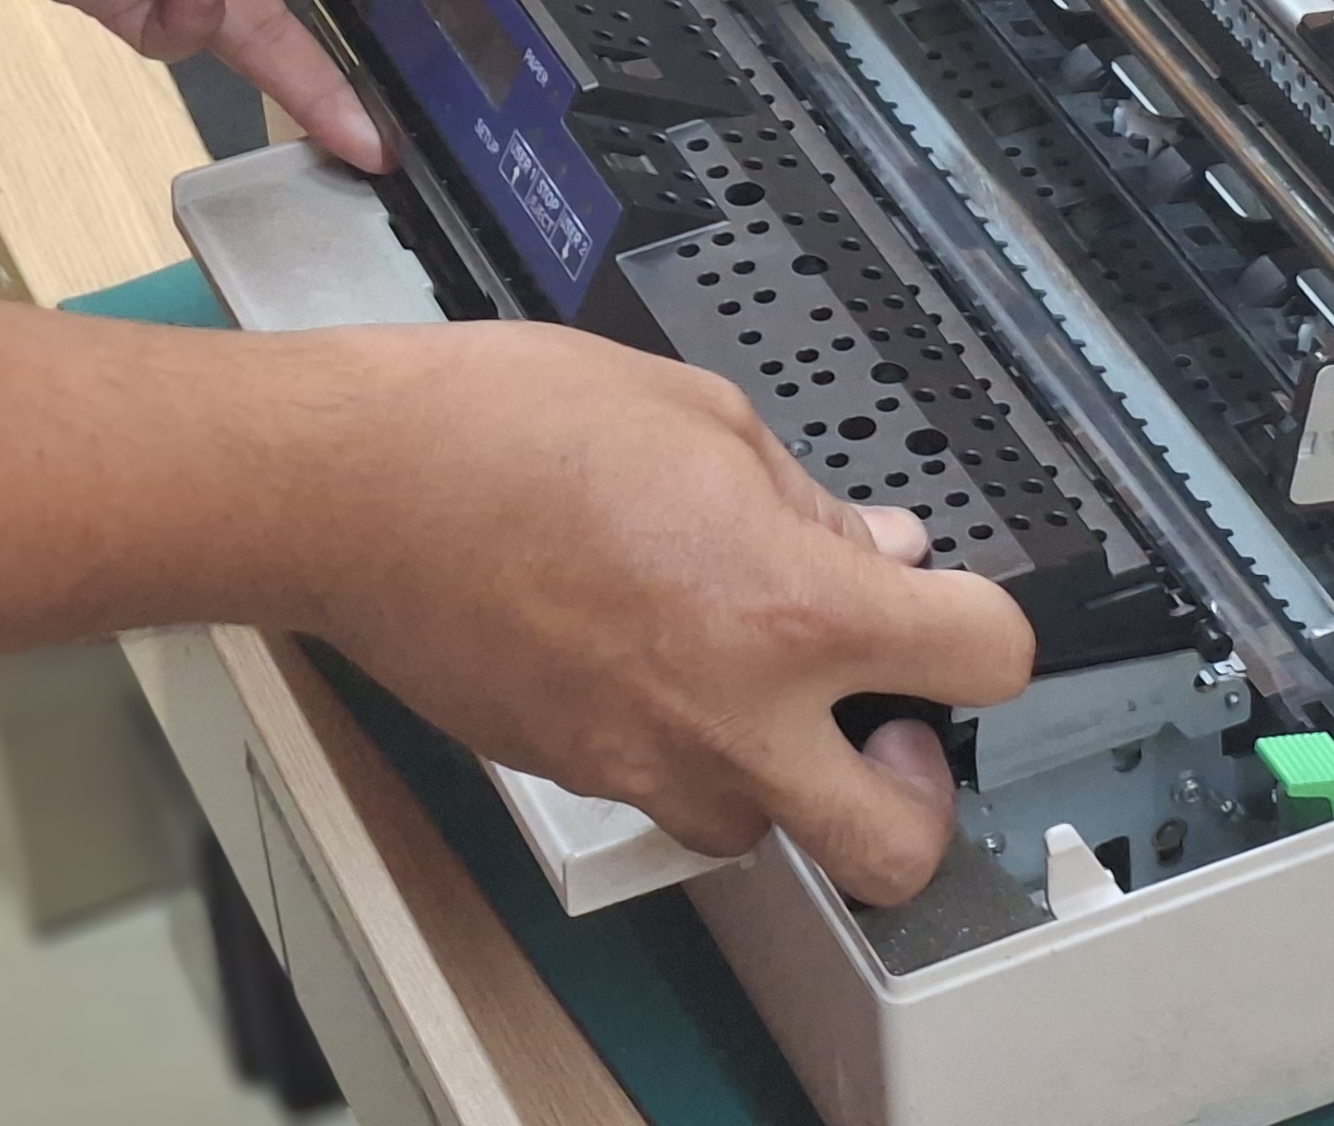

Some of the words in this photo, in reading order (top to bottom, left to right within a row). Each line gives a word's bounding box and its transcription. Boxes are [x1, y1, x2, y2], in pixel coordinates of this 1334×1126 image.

[523, 47, 549, 88] PAPER
[474, 118, 500, 153] SETUP
[510, 143, 533, 175] USER
[536, 178, 560, 210] STOP
[559, 218, 582, 249] USER
